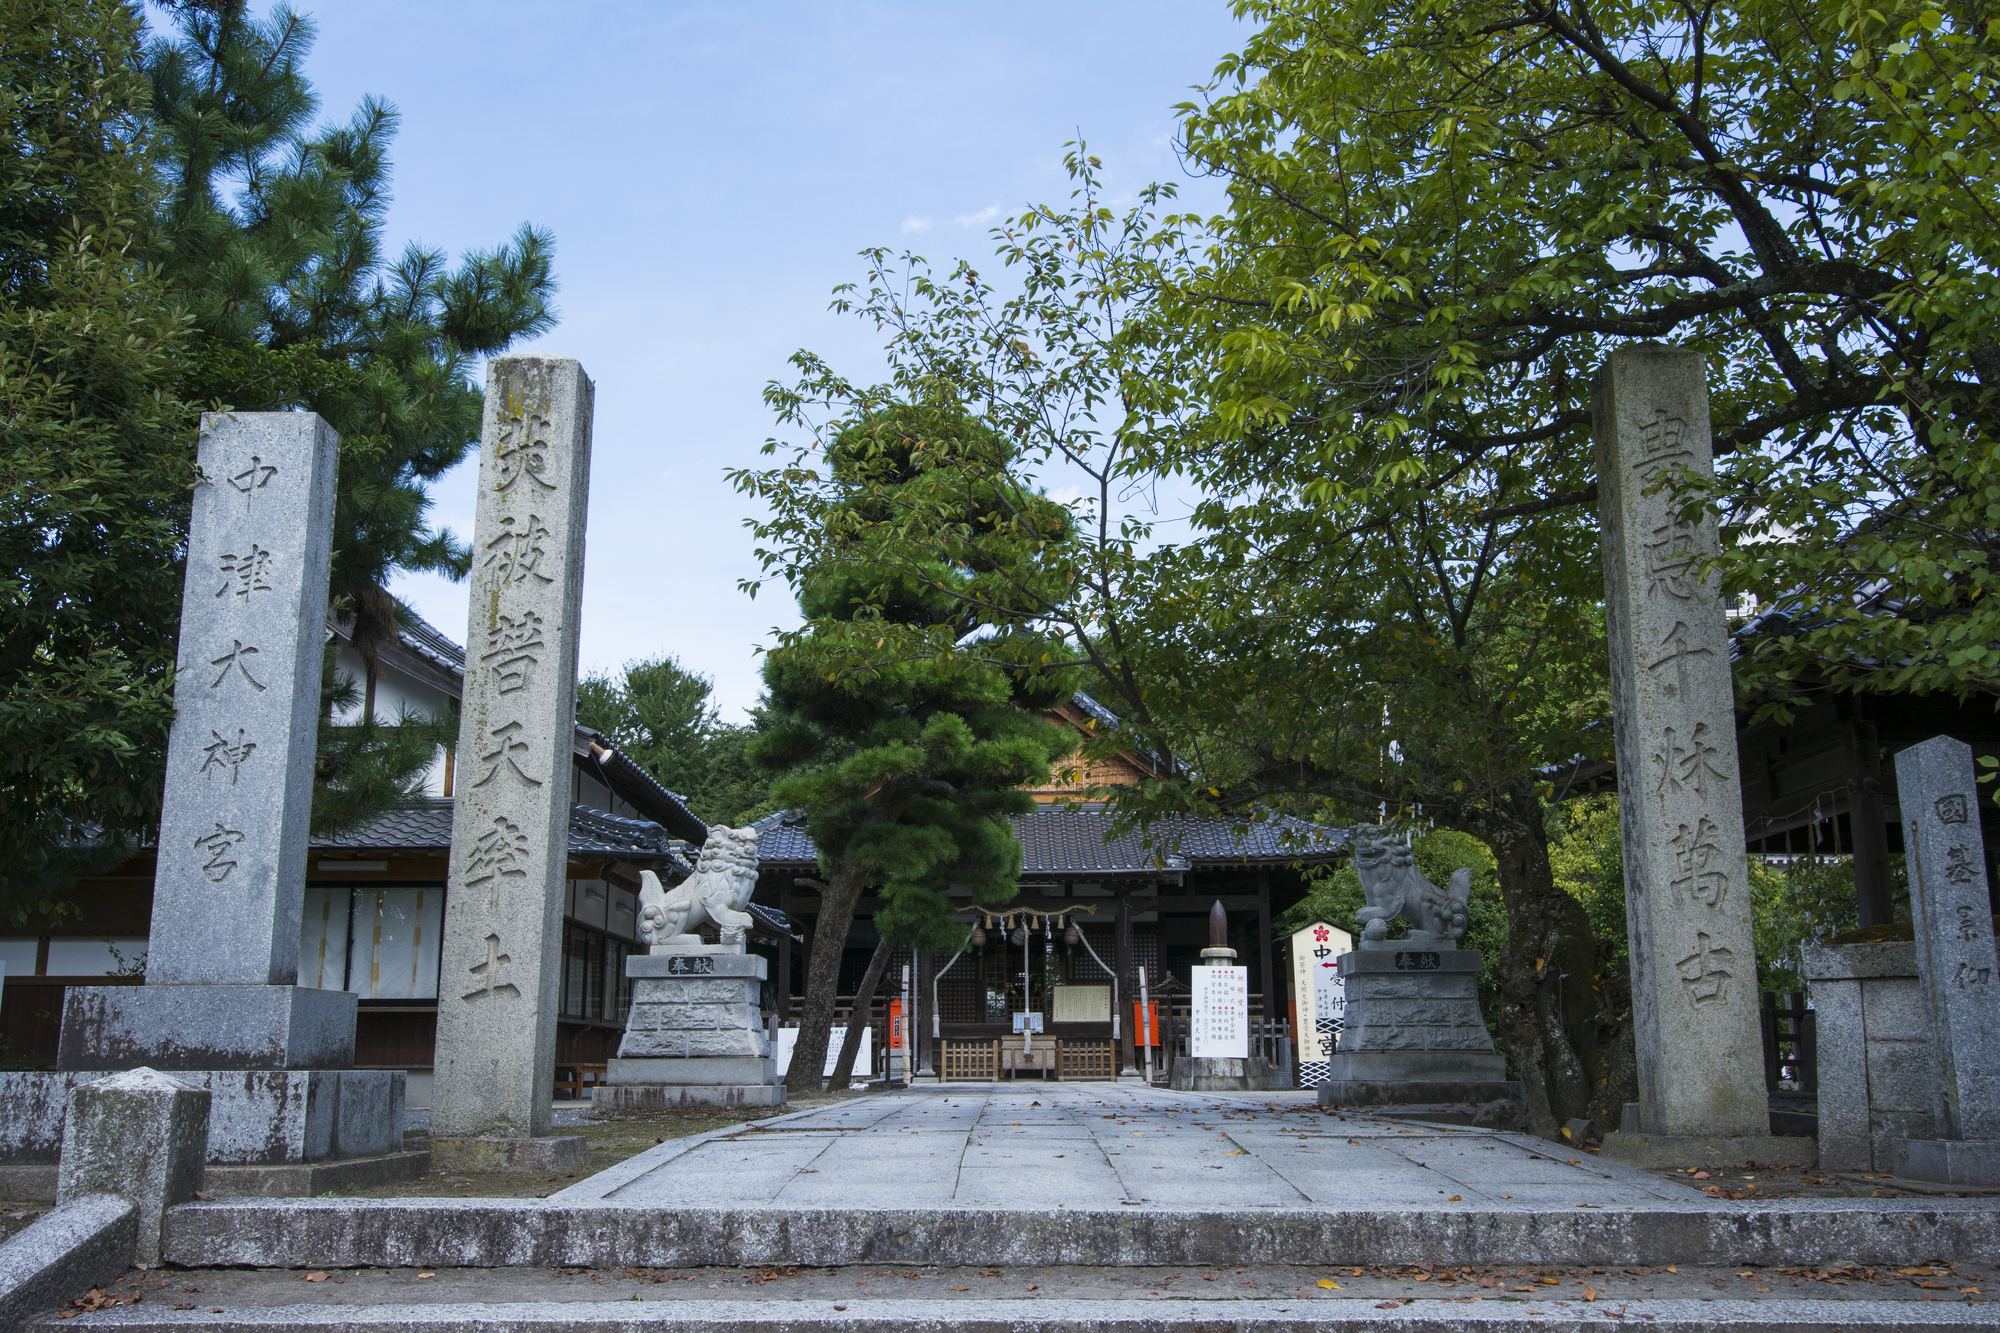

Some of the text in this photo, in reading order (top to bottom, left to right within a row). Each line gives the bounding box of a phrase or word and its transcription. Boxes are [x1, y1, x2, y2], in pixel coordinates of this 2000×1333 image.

[194, 455, 279, 884] 中津大神宮
[671, 957, 713, 975] 奉献
[1397, 952, 1438, 971] 奉献
[1330, 972, 1346, 1011] 受付
